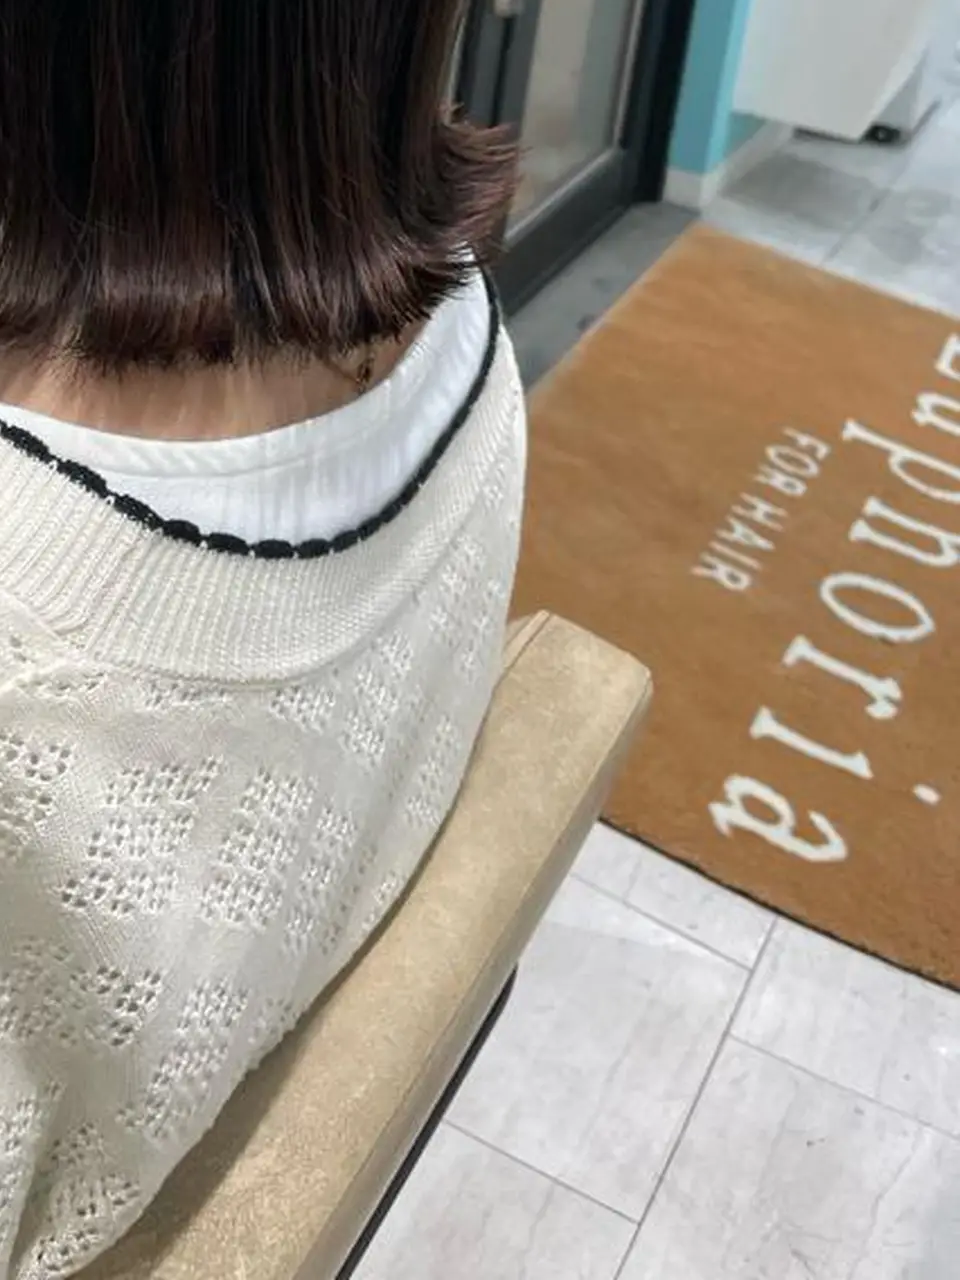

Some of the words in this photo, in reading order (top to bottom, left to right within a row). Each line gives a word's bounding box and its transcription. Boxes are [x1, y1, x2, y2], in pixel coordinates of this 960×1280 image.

[753, 426, 830, 498] FOR
[691, 492, 788, 591] HAIR
[708, 332, 960, 863] uphoria
